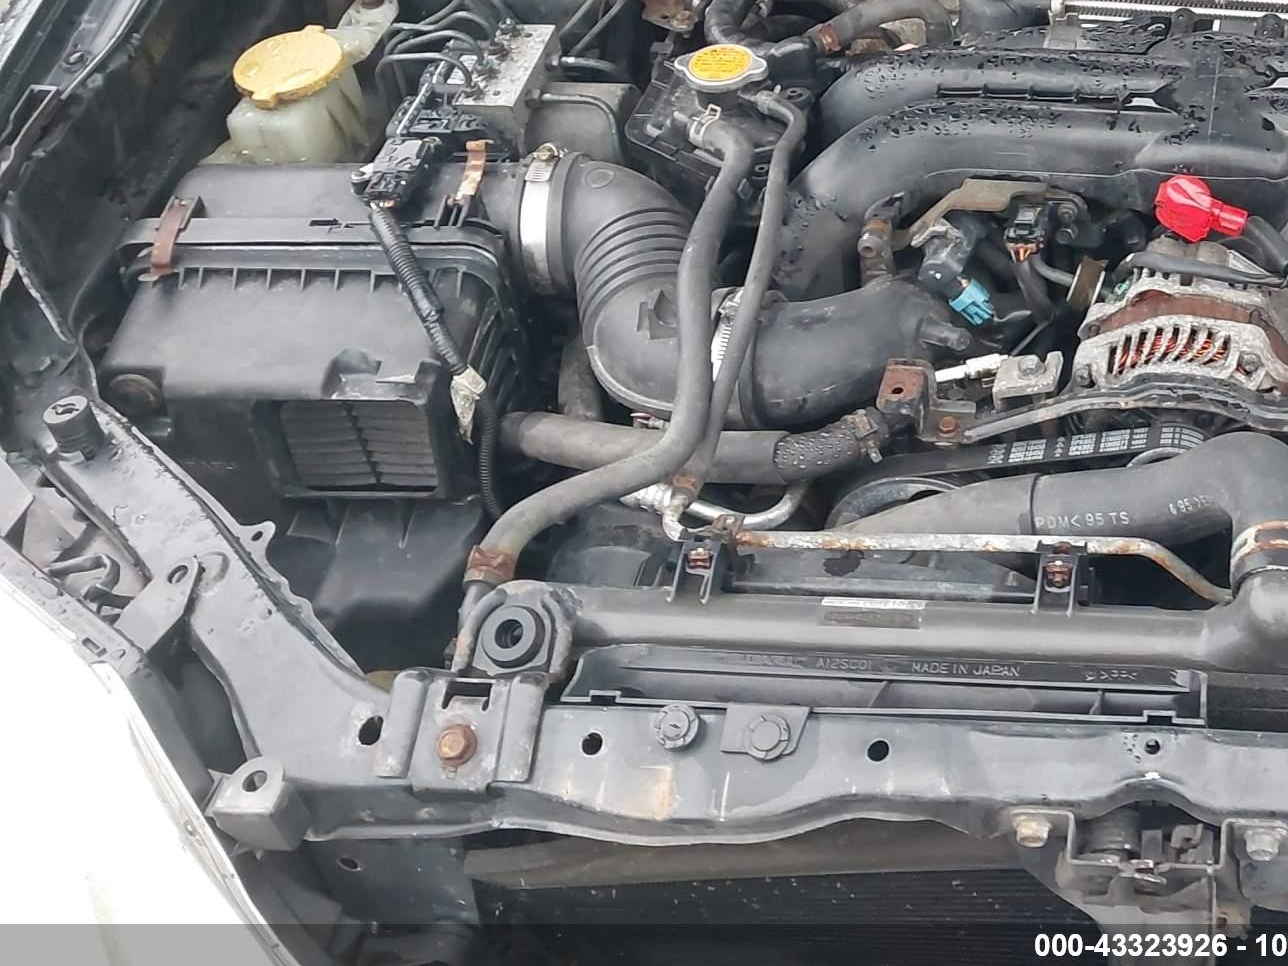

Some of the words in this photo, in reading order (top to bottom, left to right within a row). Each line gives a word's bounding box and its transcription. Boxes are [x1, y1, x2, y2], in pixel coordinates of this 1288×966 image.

[1085, 512, 1105, 526] 95
[1108, 511, 1130, 525] TS
[911, 661, 949, 675] MADE
[952, 662, 968, 676] IN
[972, 663, 1021, 678] JAPAN
